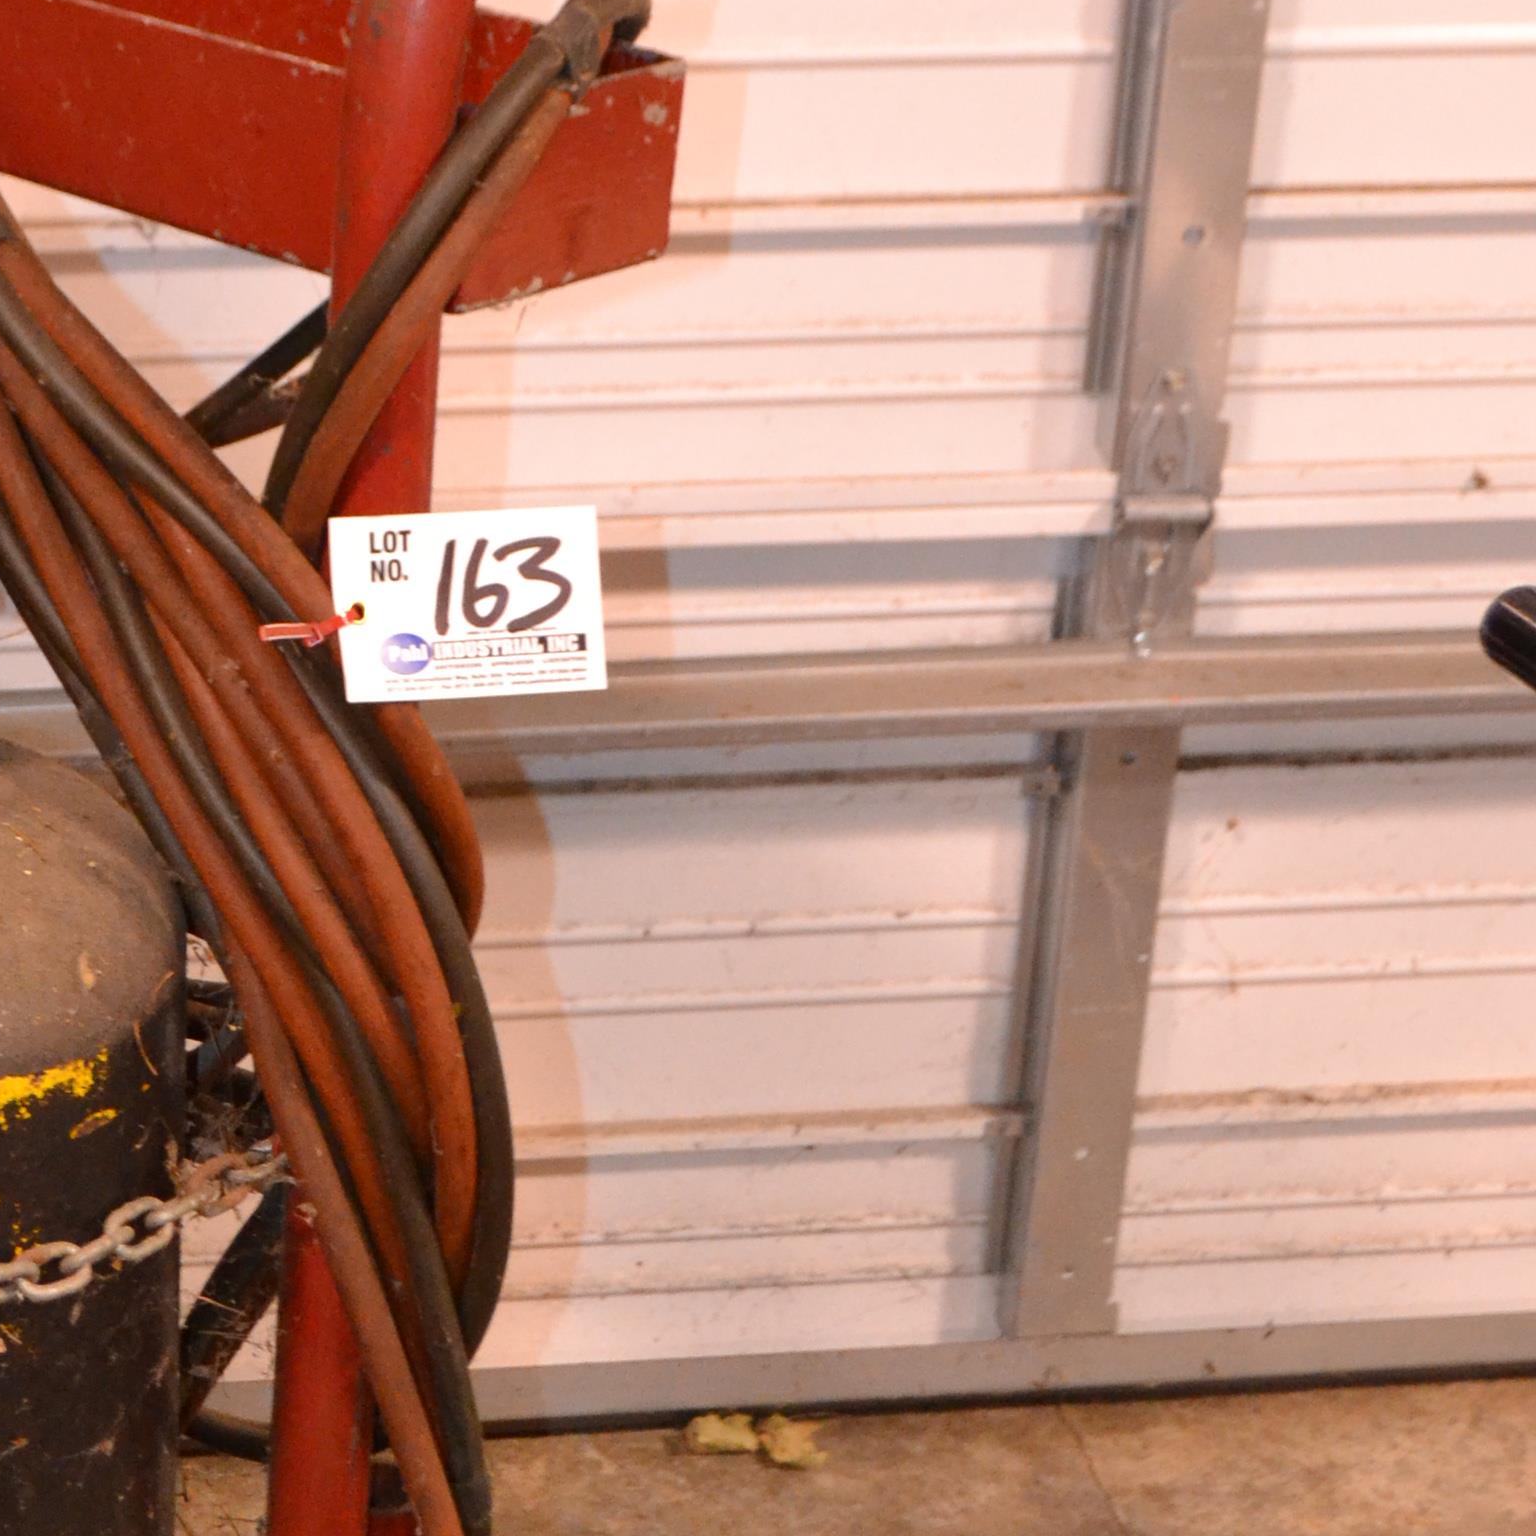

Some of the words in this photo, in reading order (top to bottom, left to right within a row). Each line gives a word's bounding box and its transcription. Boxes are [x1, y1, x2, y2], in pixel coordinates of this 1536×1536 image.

[369, 530, 411, 554] LOT
[371, 559, 409, 582] NO.
[434, 536, 572, 635] 163
[433, 638, 542, 659] INDUSTRIAL
[547, 635, 579, 653] INC
